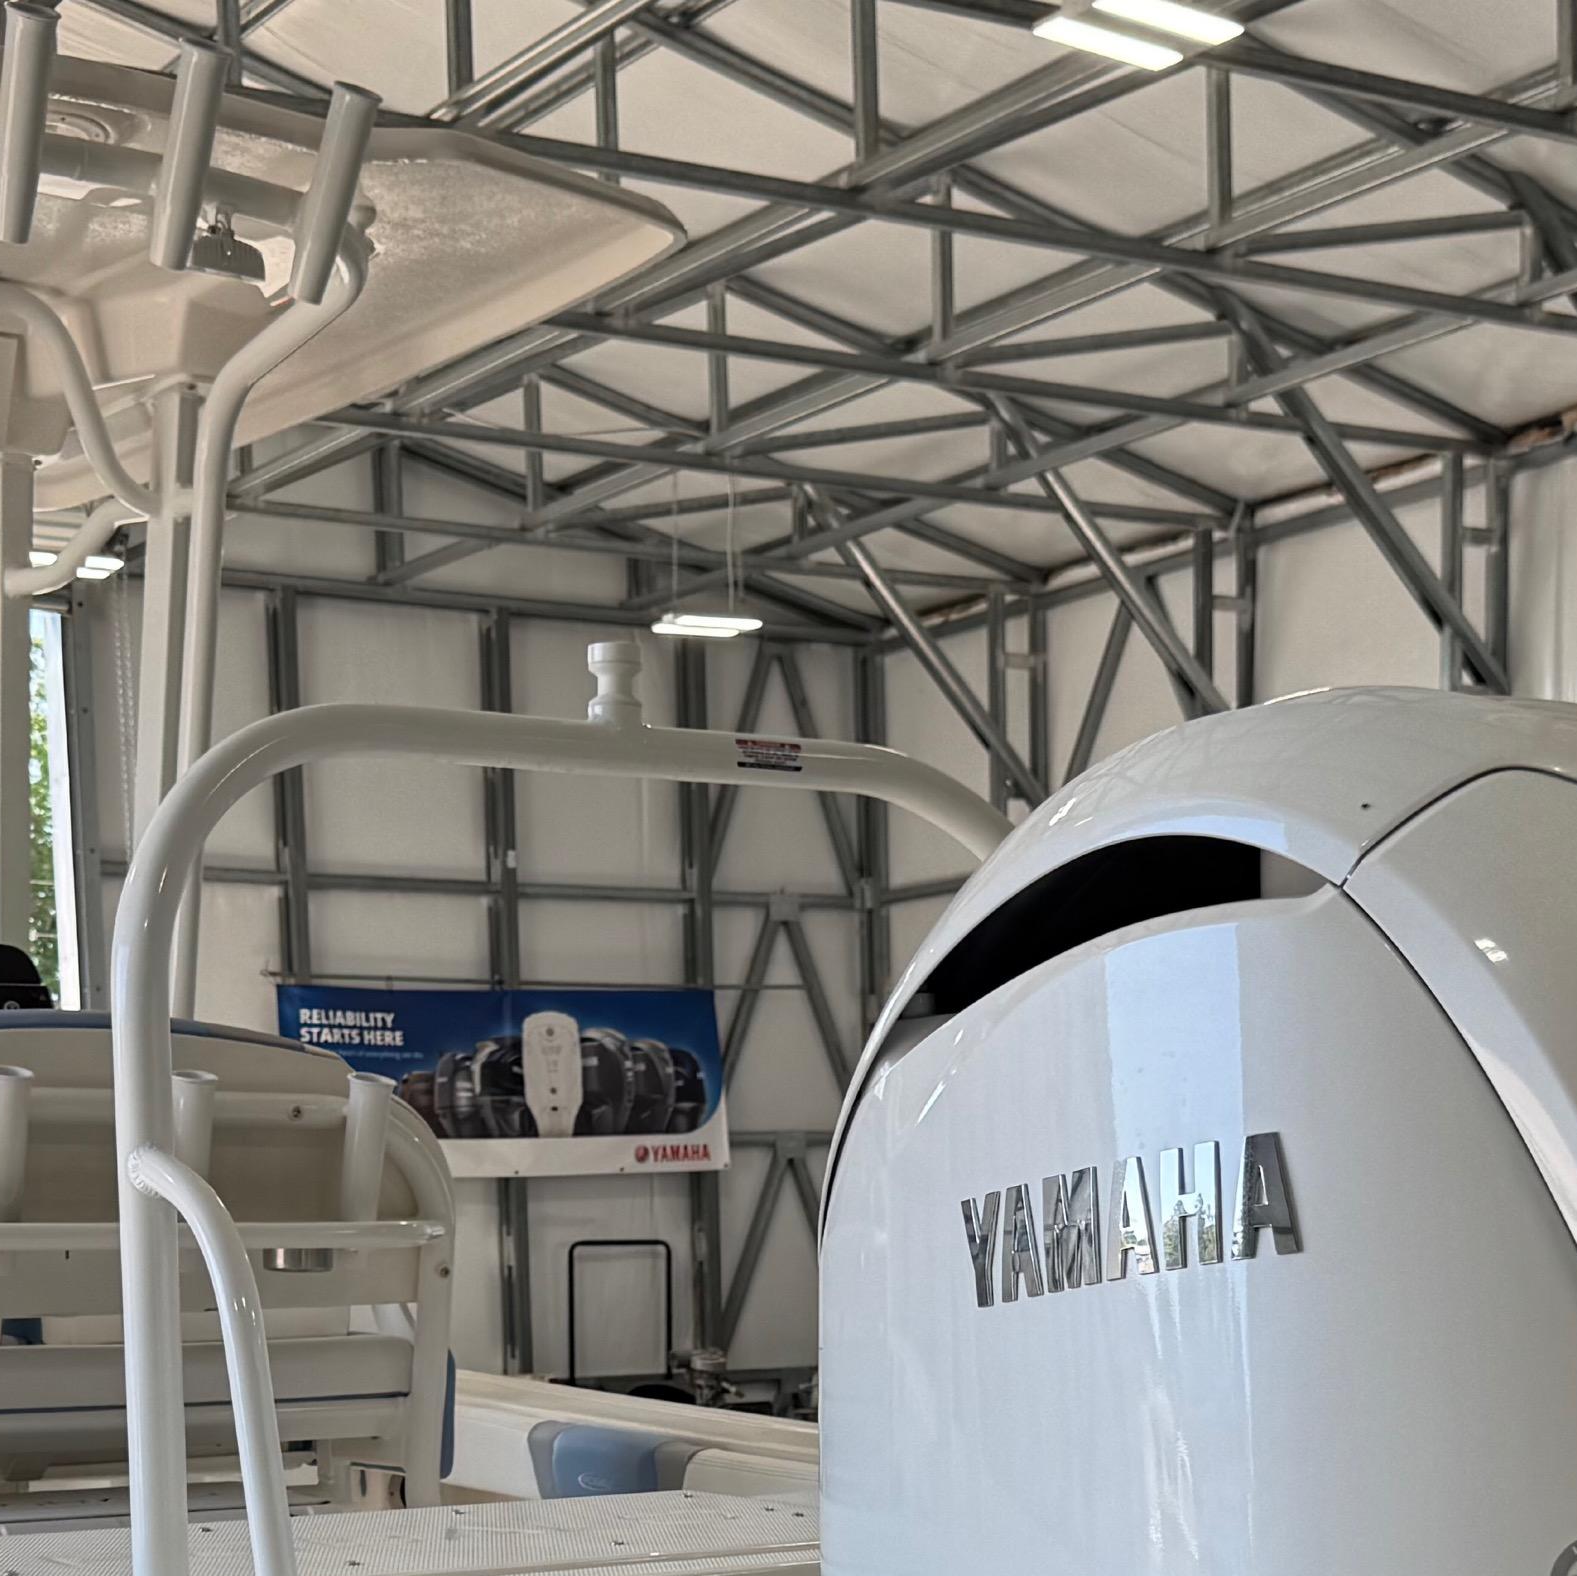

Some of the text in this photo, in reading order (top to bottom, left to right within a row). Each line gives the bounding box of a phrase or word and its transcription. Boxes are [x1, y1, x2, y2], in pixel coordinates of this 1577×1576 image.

[298, 1008, 396, 1029] RELIABILITY
[299, 1026, 404, 1047] STARTS HERE
[651, 1143, 712, 1164] YAMAHA
[960, 1131, 1304, 1308] YAMAHA
